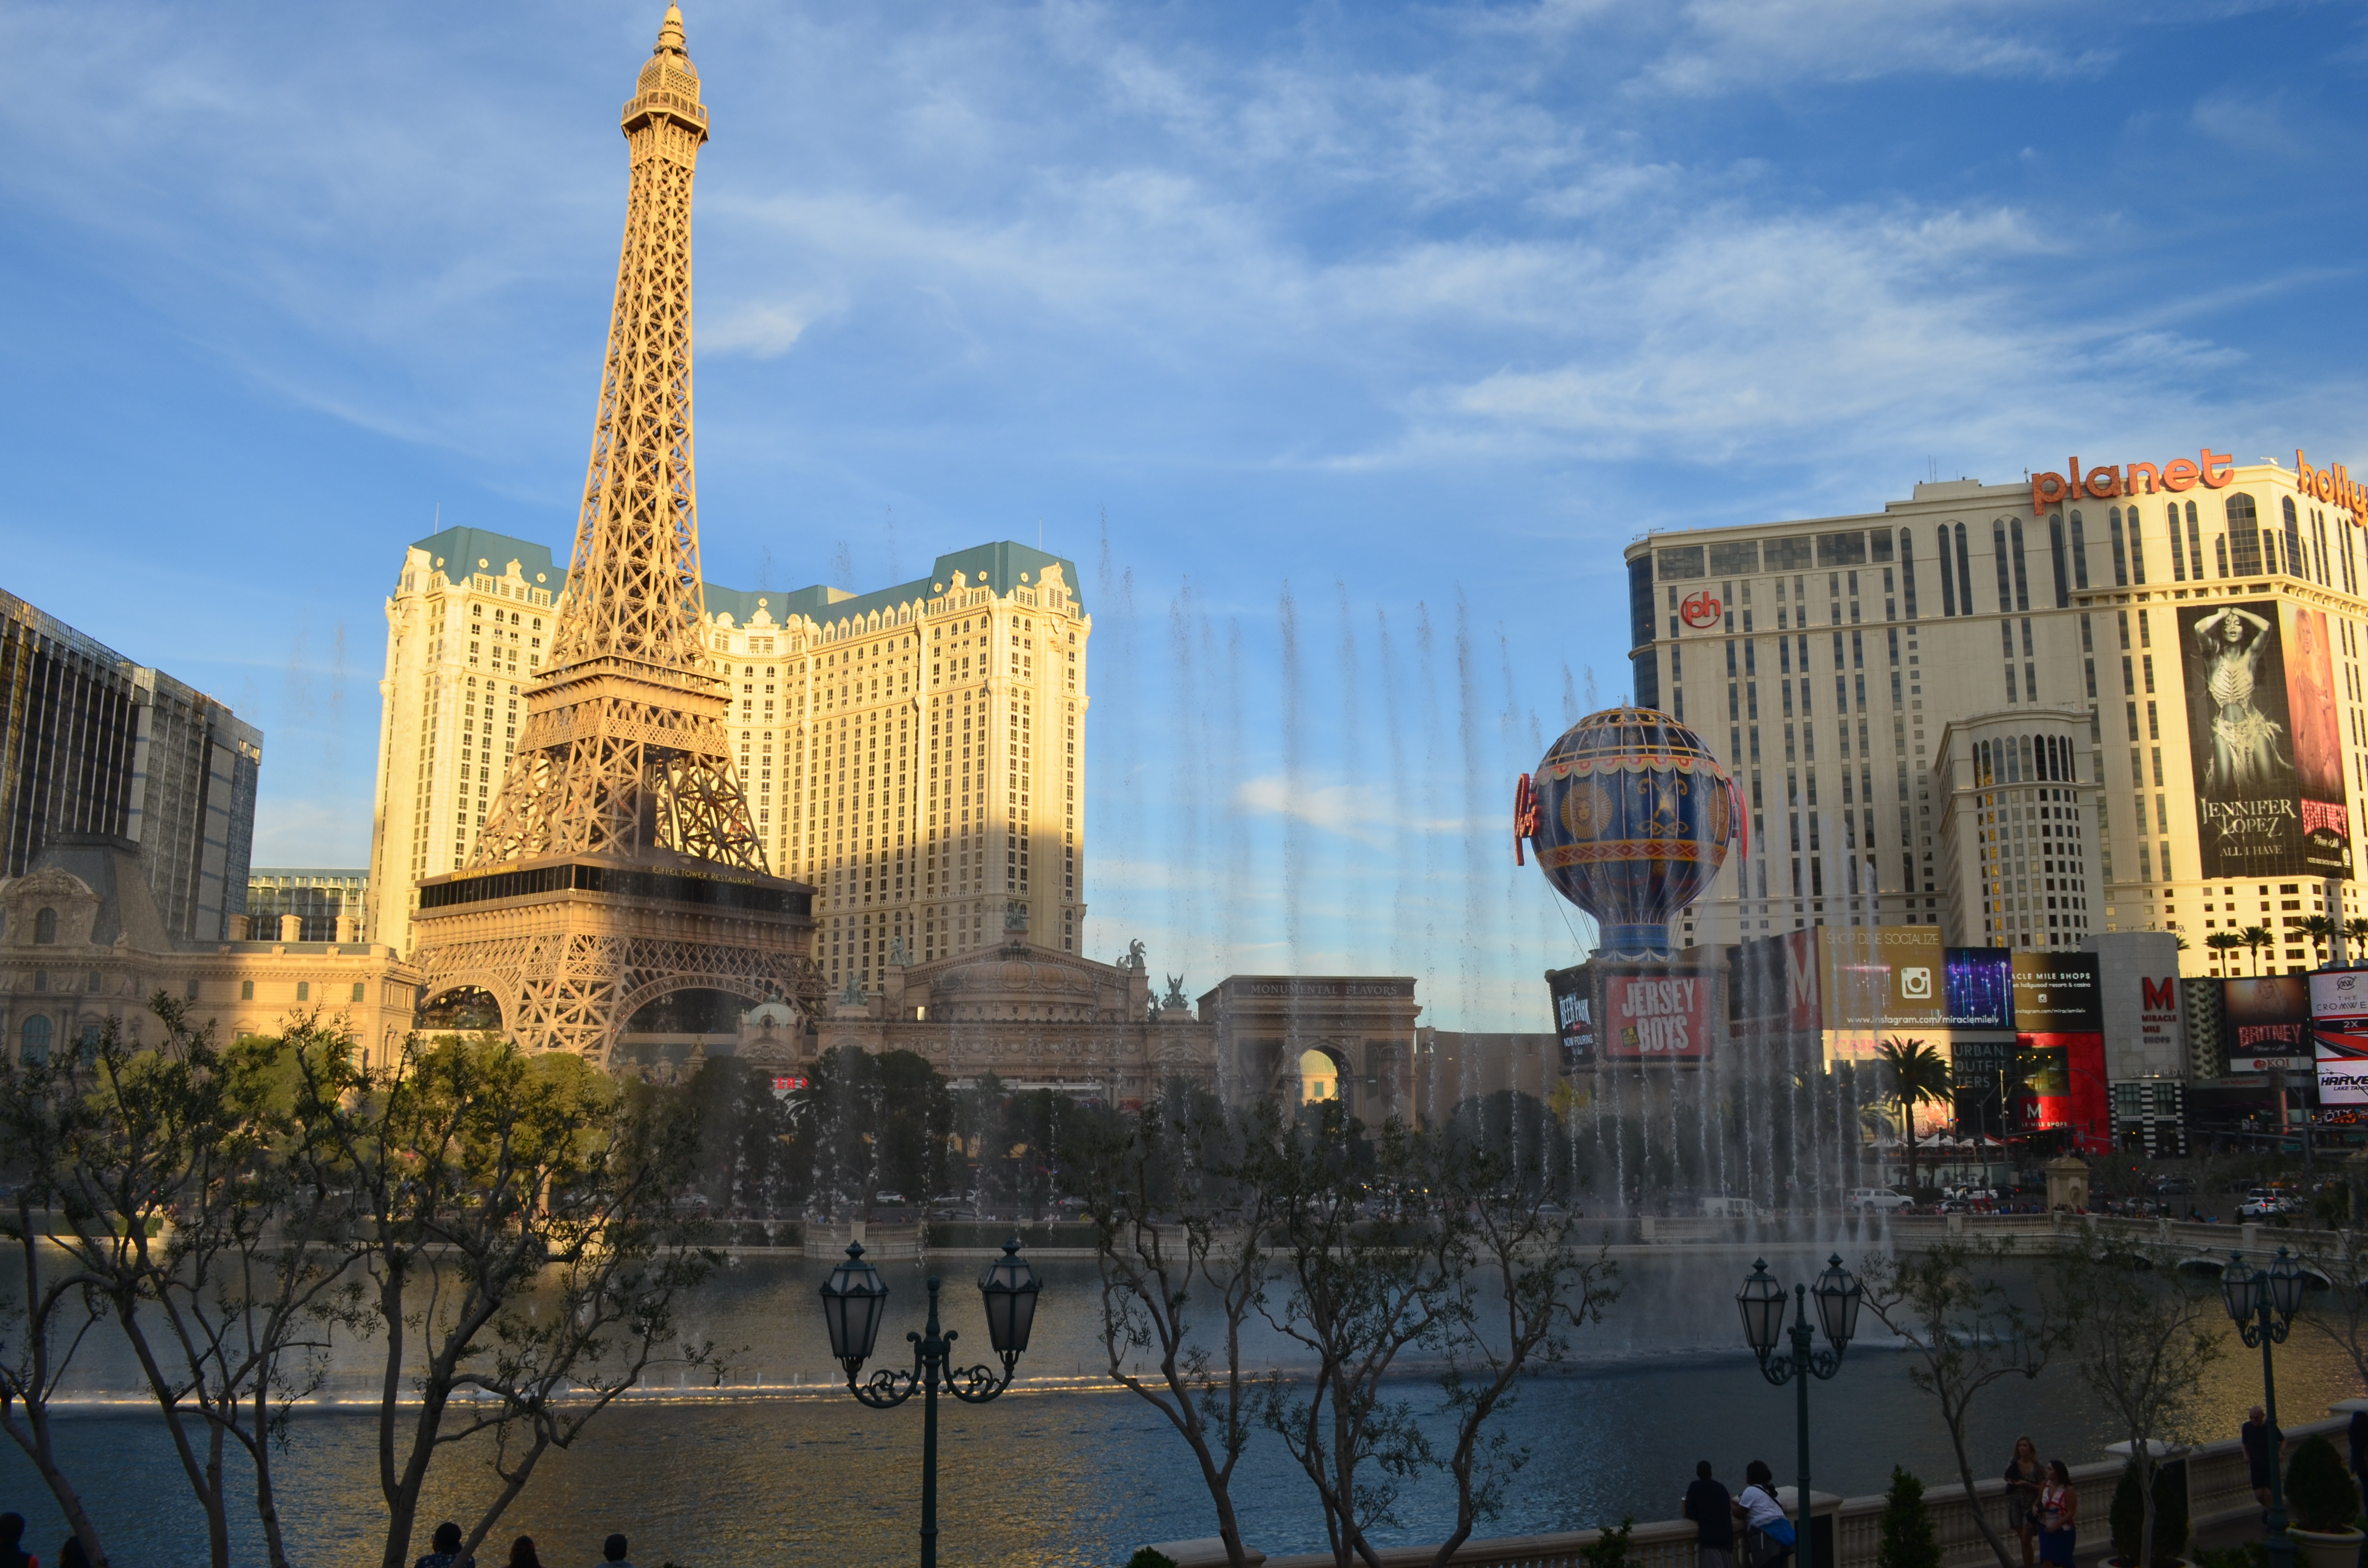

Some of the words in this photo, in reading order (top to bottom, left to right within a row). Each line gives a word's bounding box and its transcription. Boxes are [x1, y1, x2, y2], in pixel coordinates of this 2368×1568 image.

[2032, 449, 2234, 516] planet
[2296, 449, 2368, 527] holly
[1686, 591, 1721, 624] ph
[2201, 798, 2297, 824] JENNIFER
[2301, 798, 2348, 840] BRITNEY
[2222, 815, 2282, 838] LOPEZ
[2220, 847, 2243, 857] ALL
[2246, 847, 2248, 856] I
[2254, 845, 2282, 856] HAVE
[653, 865, 678, 876] EIFFEL
[681, 869, 707, 880] TOWER
[711, 873, 755, 885] RESTAURANT
[1826, 933, 1855, 944] SHOP
[1885, 933, 1939, 945] SOCIALIZE
[1787, 941, 1817, 1008] M
[1251, 985, 1338, 994] MONUMENTAL
[1346, 985, 1397, 995] FLAVORS
[1622, 978, 1694, 1017] JERSEY
[2142, 977, 2175, 1011] M
[1564, 1037, 1574, 1047] NOW
[1574, 1034, 1593, 1045] POURING
[1637, 1015, 1689, 1052] BOYS
[2238, 1024, 2302, 1048] BRITNEY
[1953, 1045, 2003, 1056] URBAN
[1954, 1061, 2006, 1072] OUTFIT
[2267, 1058, 2290, 1067] KOI
[771, 1078, 796, 1089] ER
[1956, 1076, 1990, 1088] TERS
[2027, 1103, 2042, 1118] M
